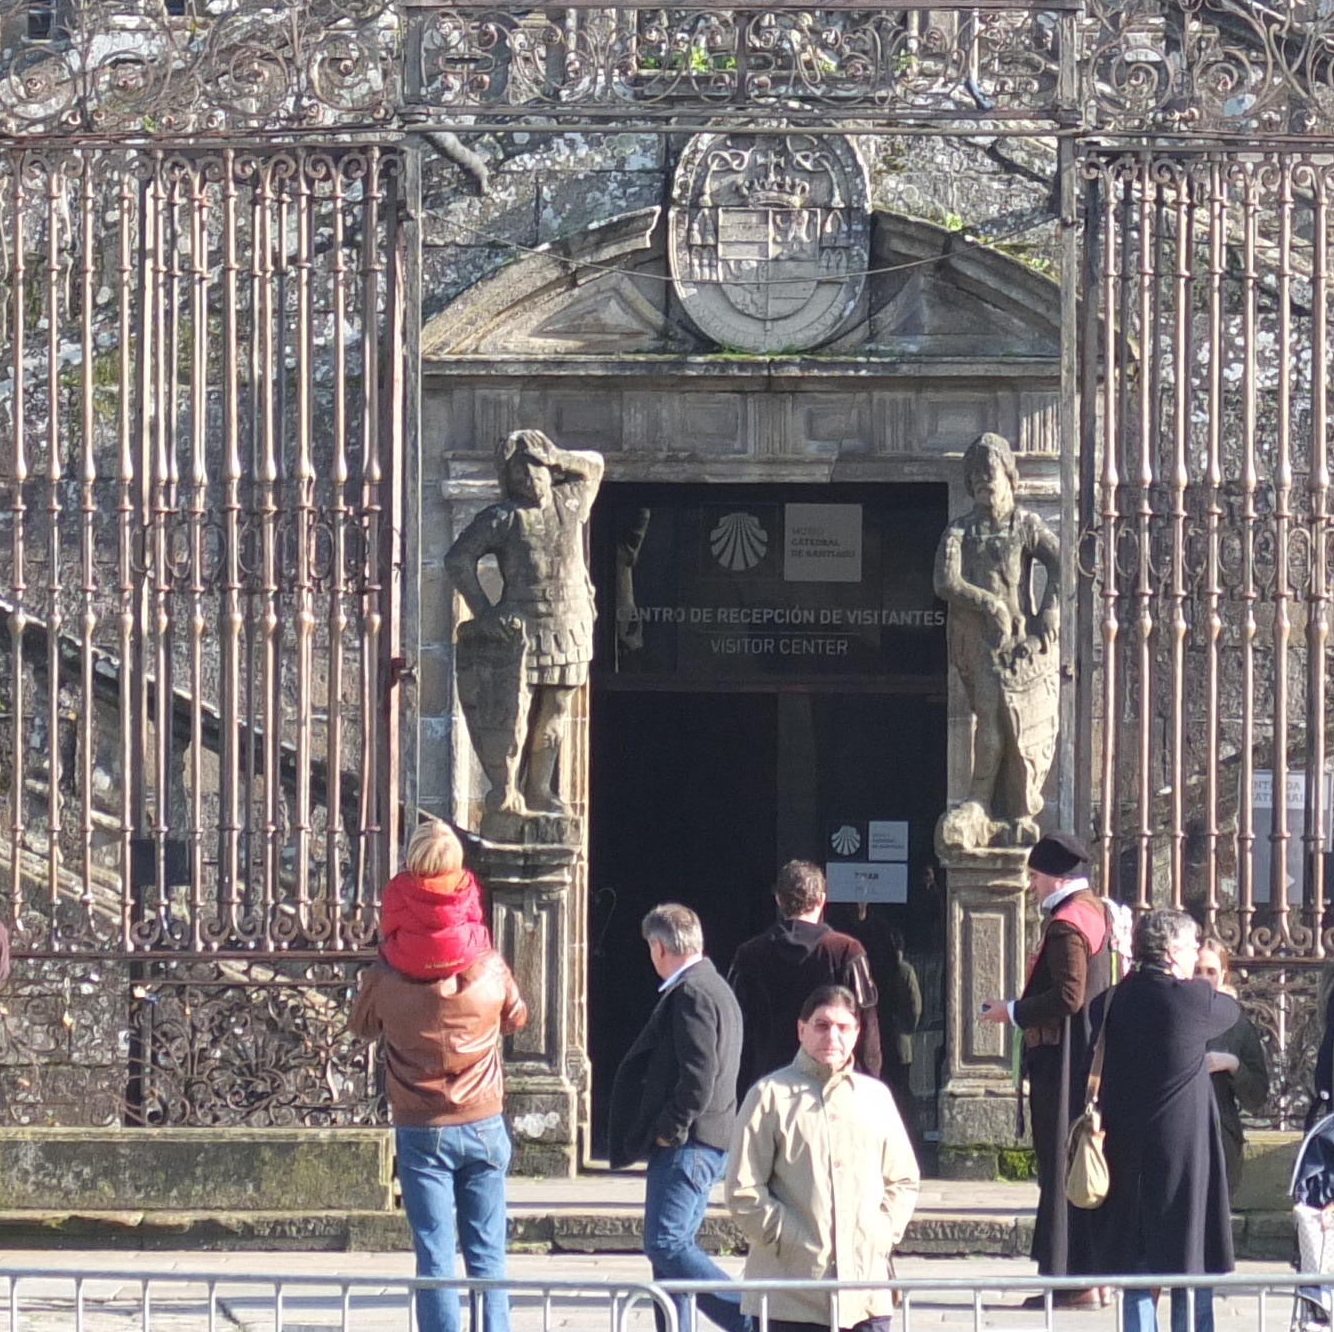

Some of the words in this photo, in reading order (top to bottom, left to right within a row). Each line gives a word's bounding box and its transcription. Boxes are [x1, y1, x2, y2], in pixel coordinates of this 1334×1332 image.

[791, 539, 840, 547] CATEDRAL
[791, 550, 803, 558] DE
[615, 607, 685, 625] CENTRO
[690, 607, 714, 625] DE
[717, 603, 814, 625] RECEPCIÓN
[819, 608, 843, 625] DE
[846, 608, 946, 627] VISITANTES
[710, 638, 774, 654] VISITOR
[779, 638, 848, 655] CENTER
